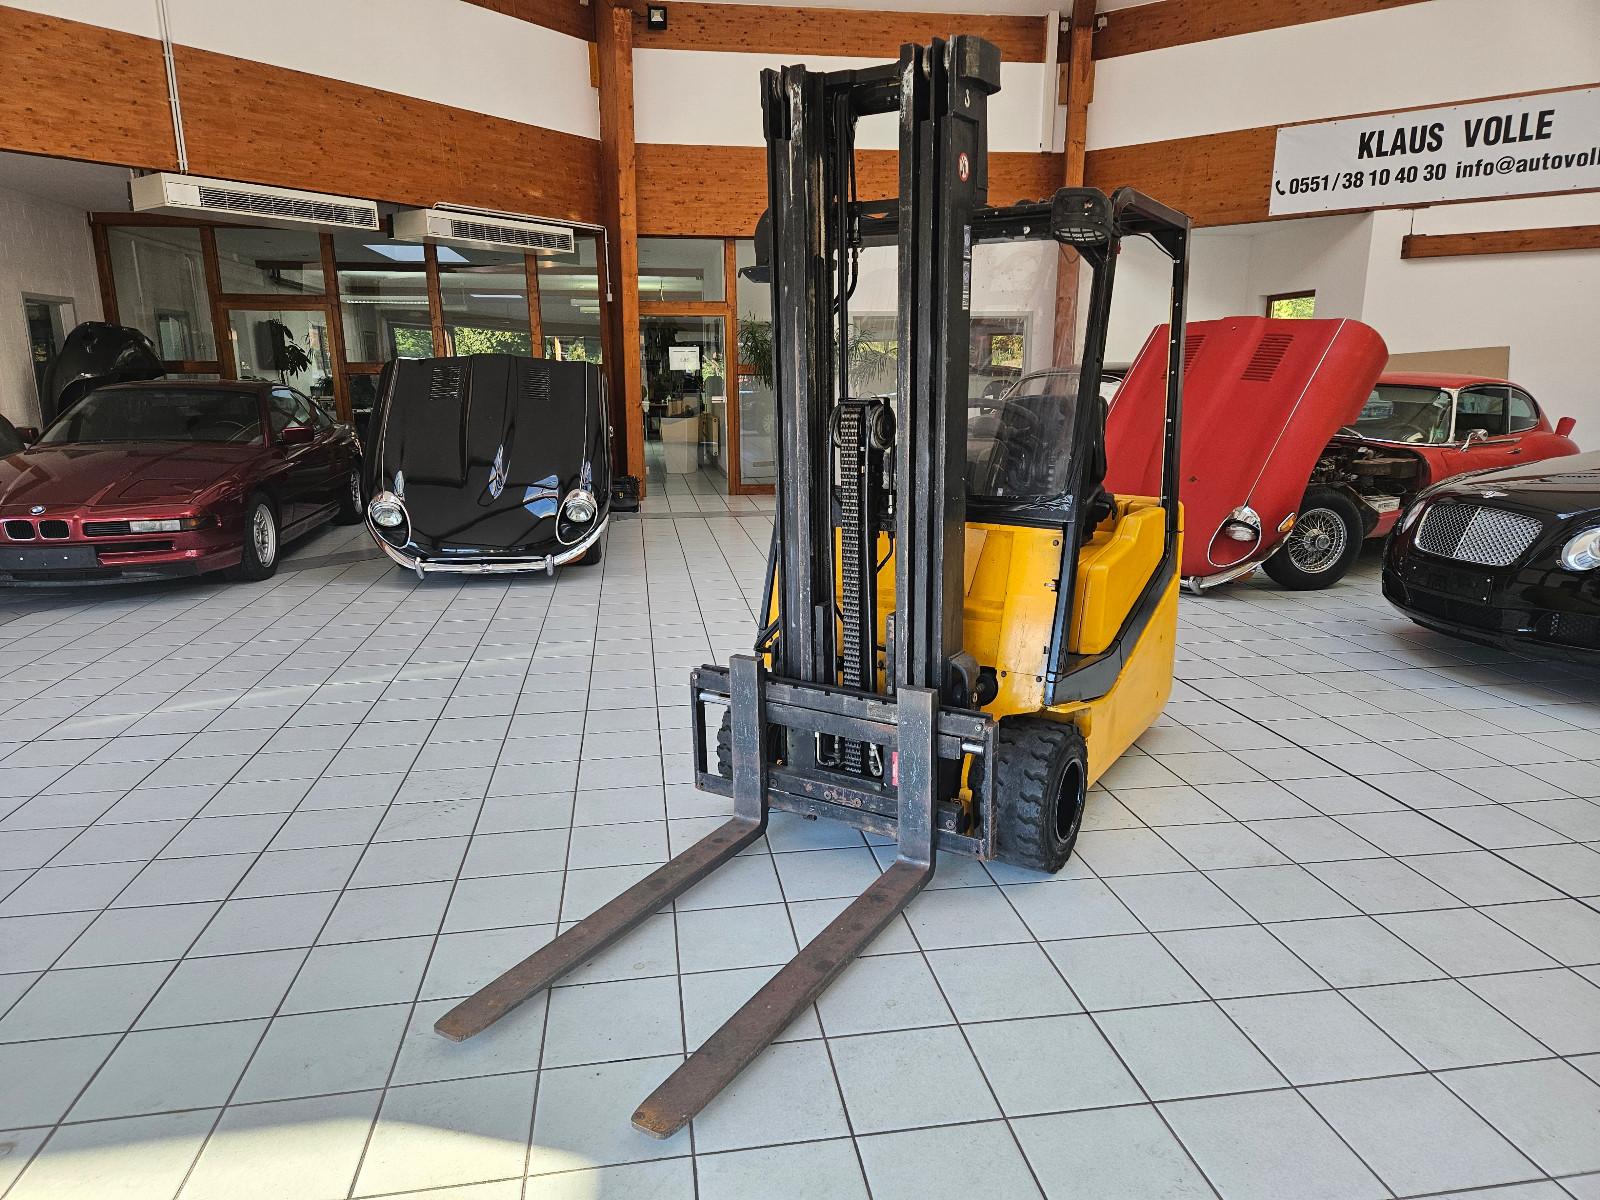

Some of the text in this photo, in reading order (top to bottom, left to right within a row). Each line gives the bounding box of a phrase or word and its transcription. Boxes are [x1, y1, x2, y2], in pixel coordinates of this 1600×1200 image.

[1357, 109, 1555, 160] KLAUS VOLLE
[1369, 168, 1390, 186] 10
[1394, 165, 1418, 184] 40
[1423, 163, 1447, 182] 30
